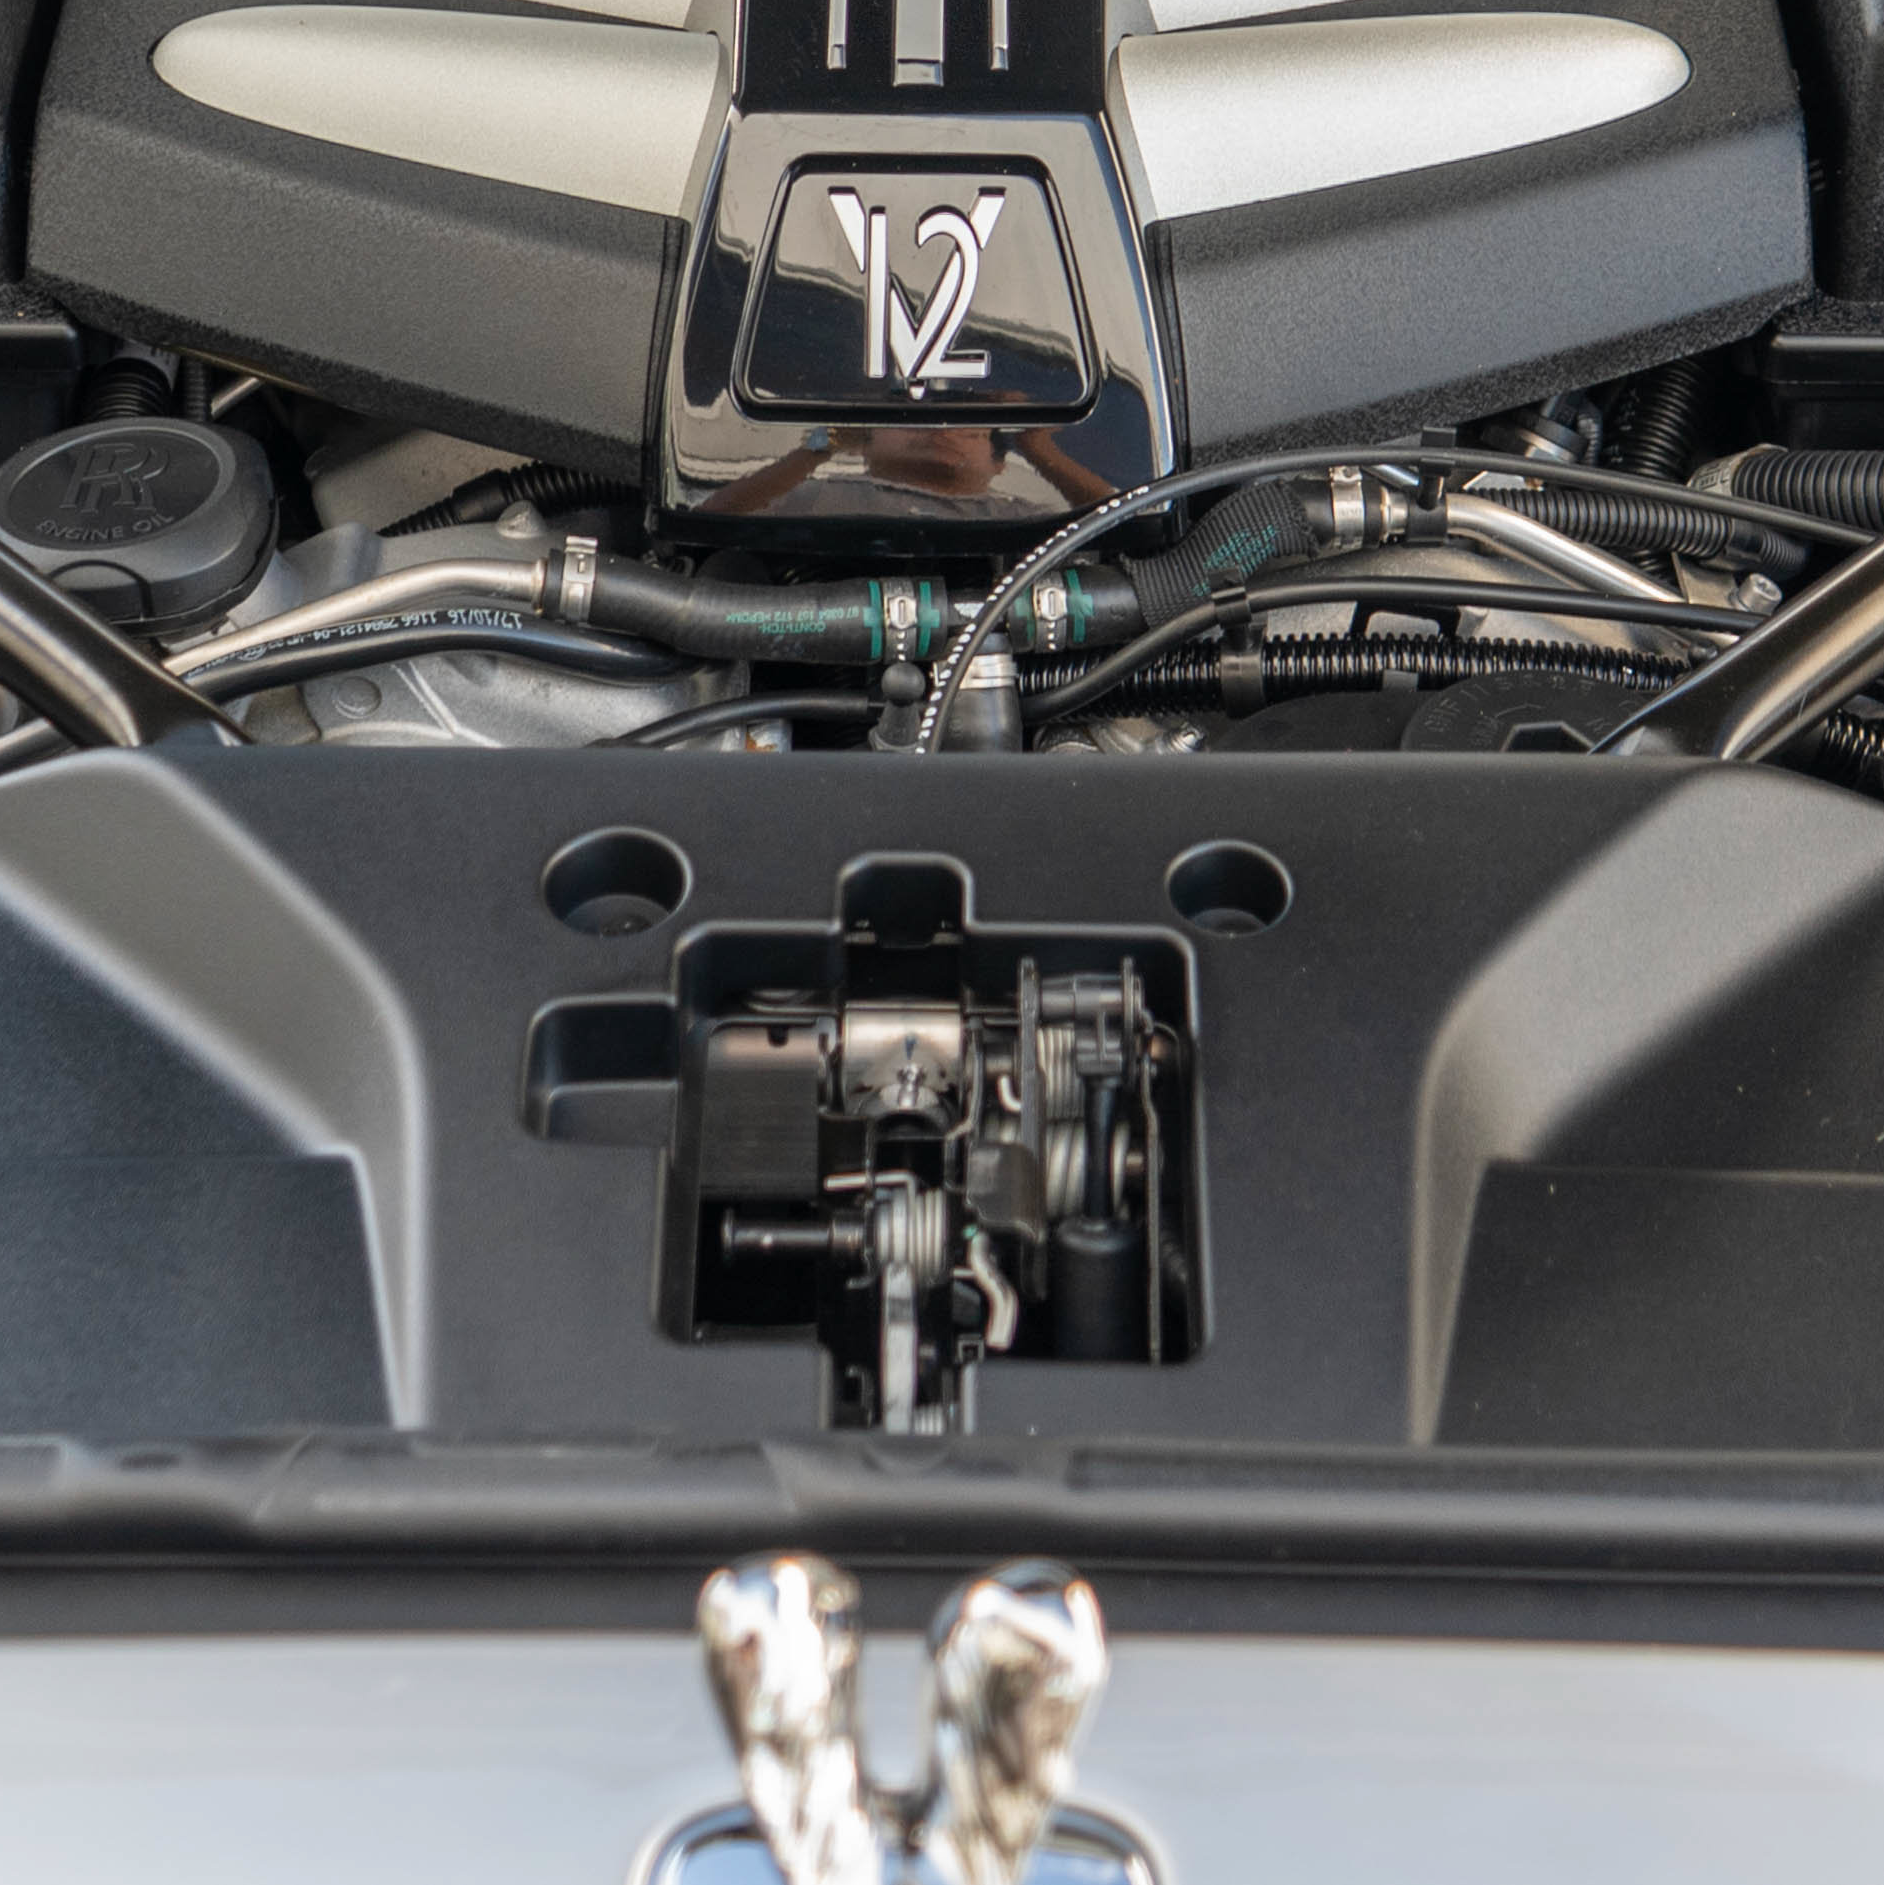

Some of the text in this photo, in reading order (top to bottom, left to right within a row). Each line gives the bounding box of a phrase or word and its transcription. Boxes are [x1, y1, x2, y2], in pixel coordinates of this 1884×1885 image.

[36, 512, 175, 542] ENGINE OIL
[400, 611, 437, 627] 1166
[447, 609, 523, 630] 17/10/16
